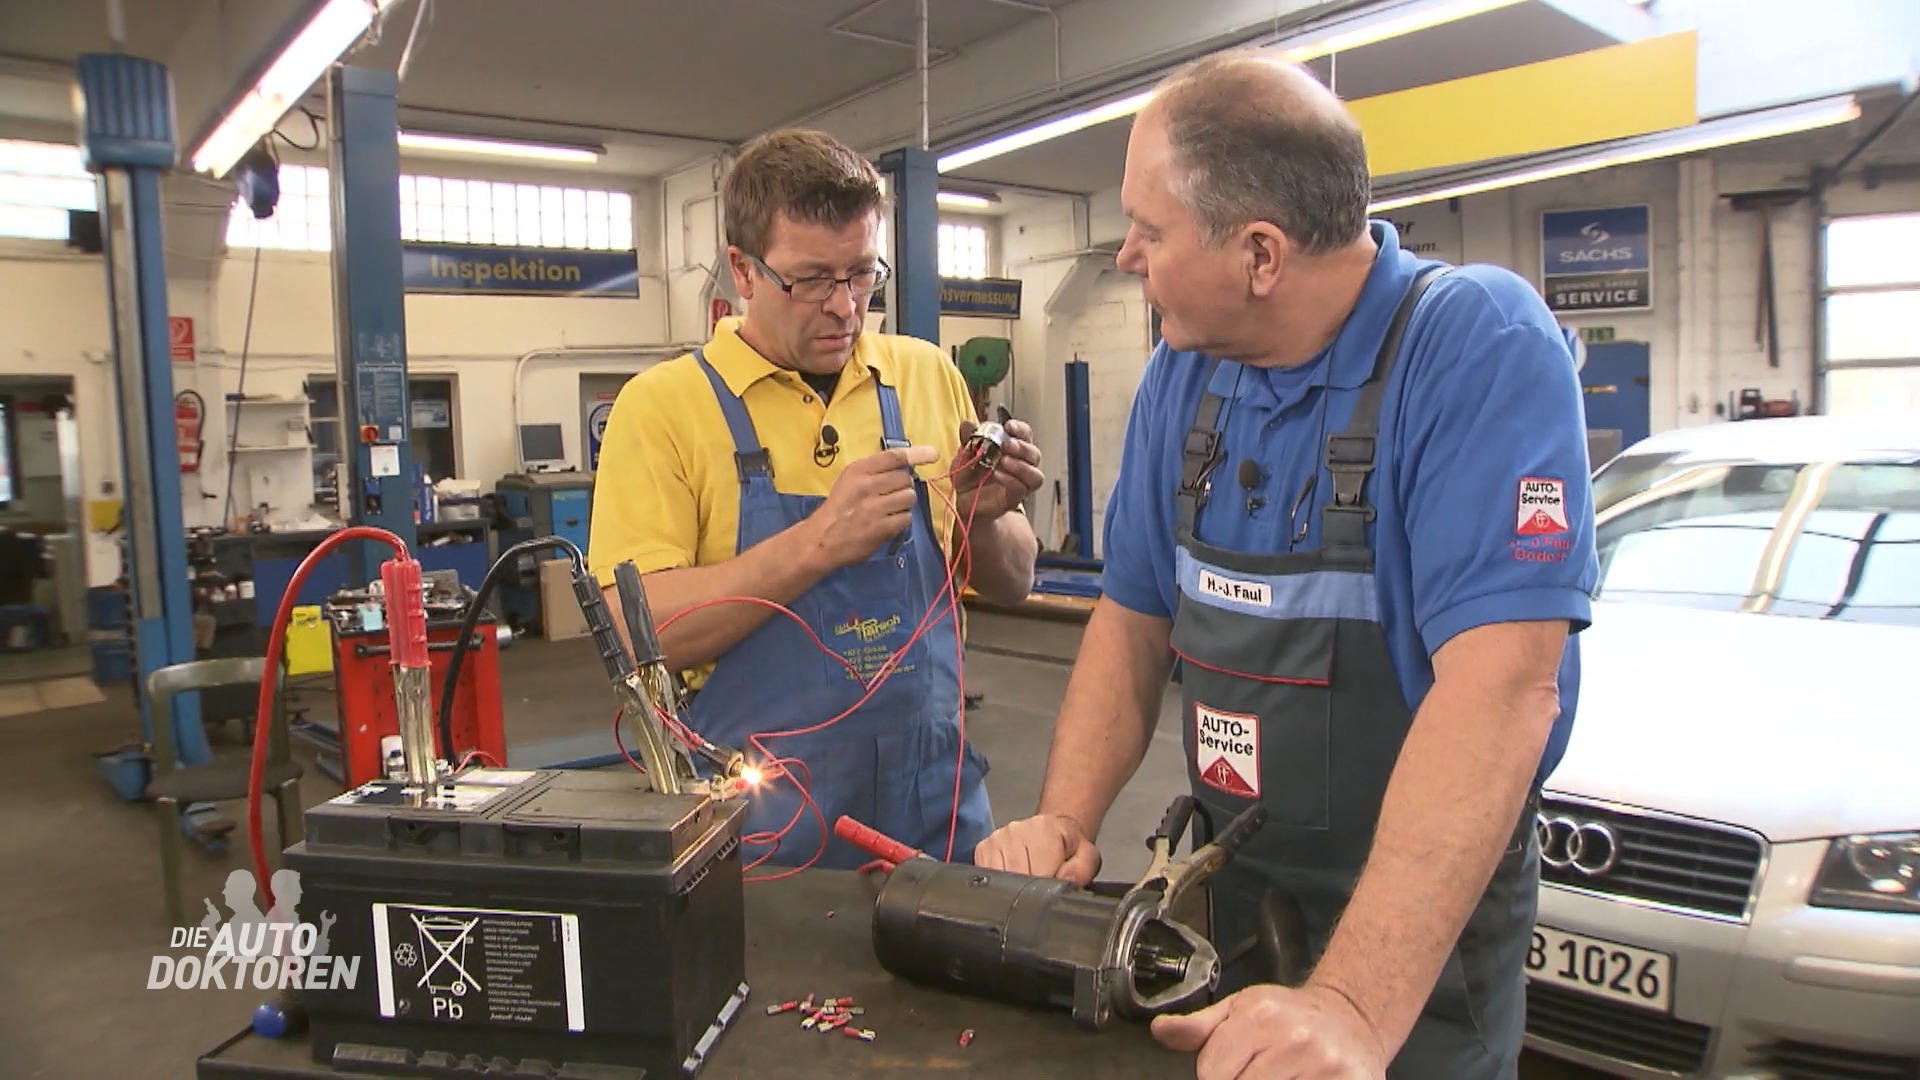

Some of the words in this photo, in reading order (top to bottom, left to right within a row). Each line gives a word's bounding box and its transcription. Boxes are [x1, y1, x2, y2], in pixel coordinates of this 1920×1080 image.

[1560, 247, 1633, 264] SACHS
[429, 255, 581, 284] Inspektion
[939, 284, 1018, 311] hsvermessung
[1556, 288, 1639, 306] SERVICE
[1521, 493, 1561, 505] Service
[1234, 585, 1262, 602] Faul
[1202, 715, 1250, 737] AUTO-
[1199, 729, 1254, 756] Service
[1557, 939, 1660, 999] 1026
[432, 996, 464, 1020] Pb
